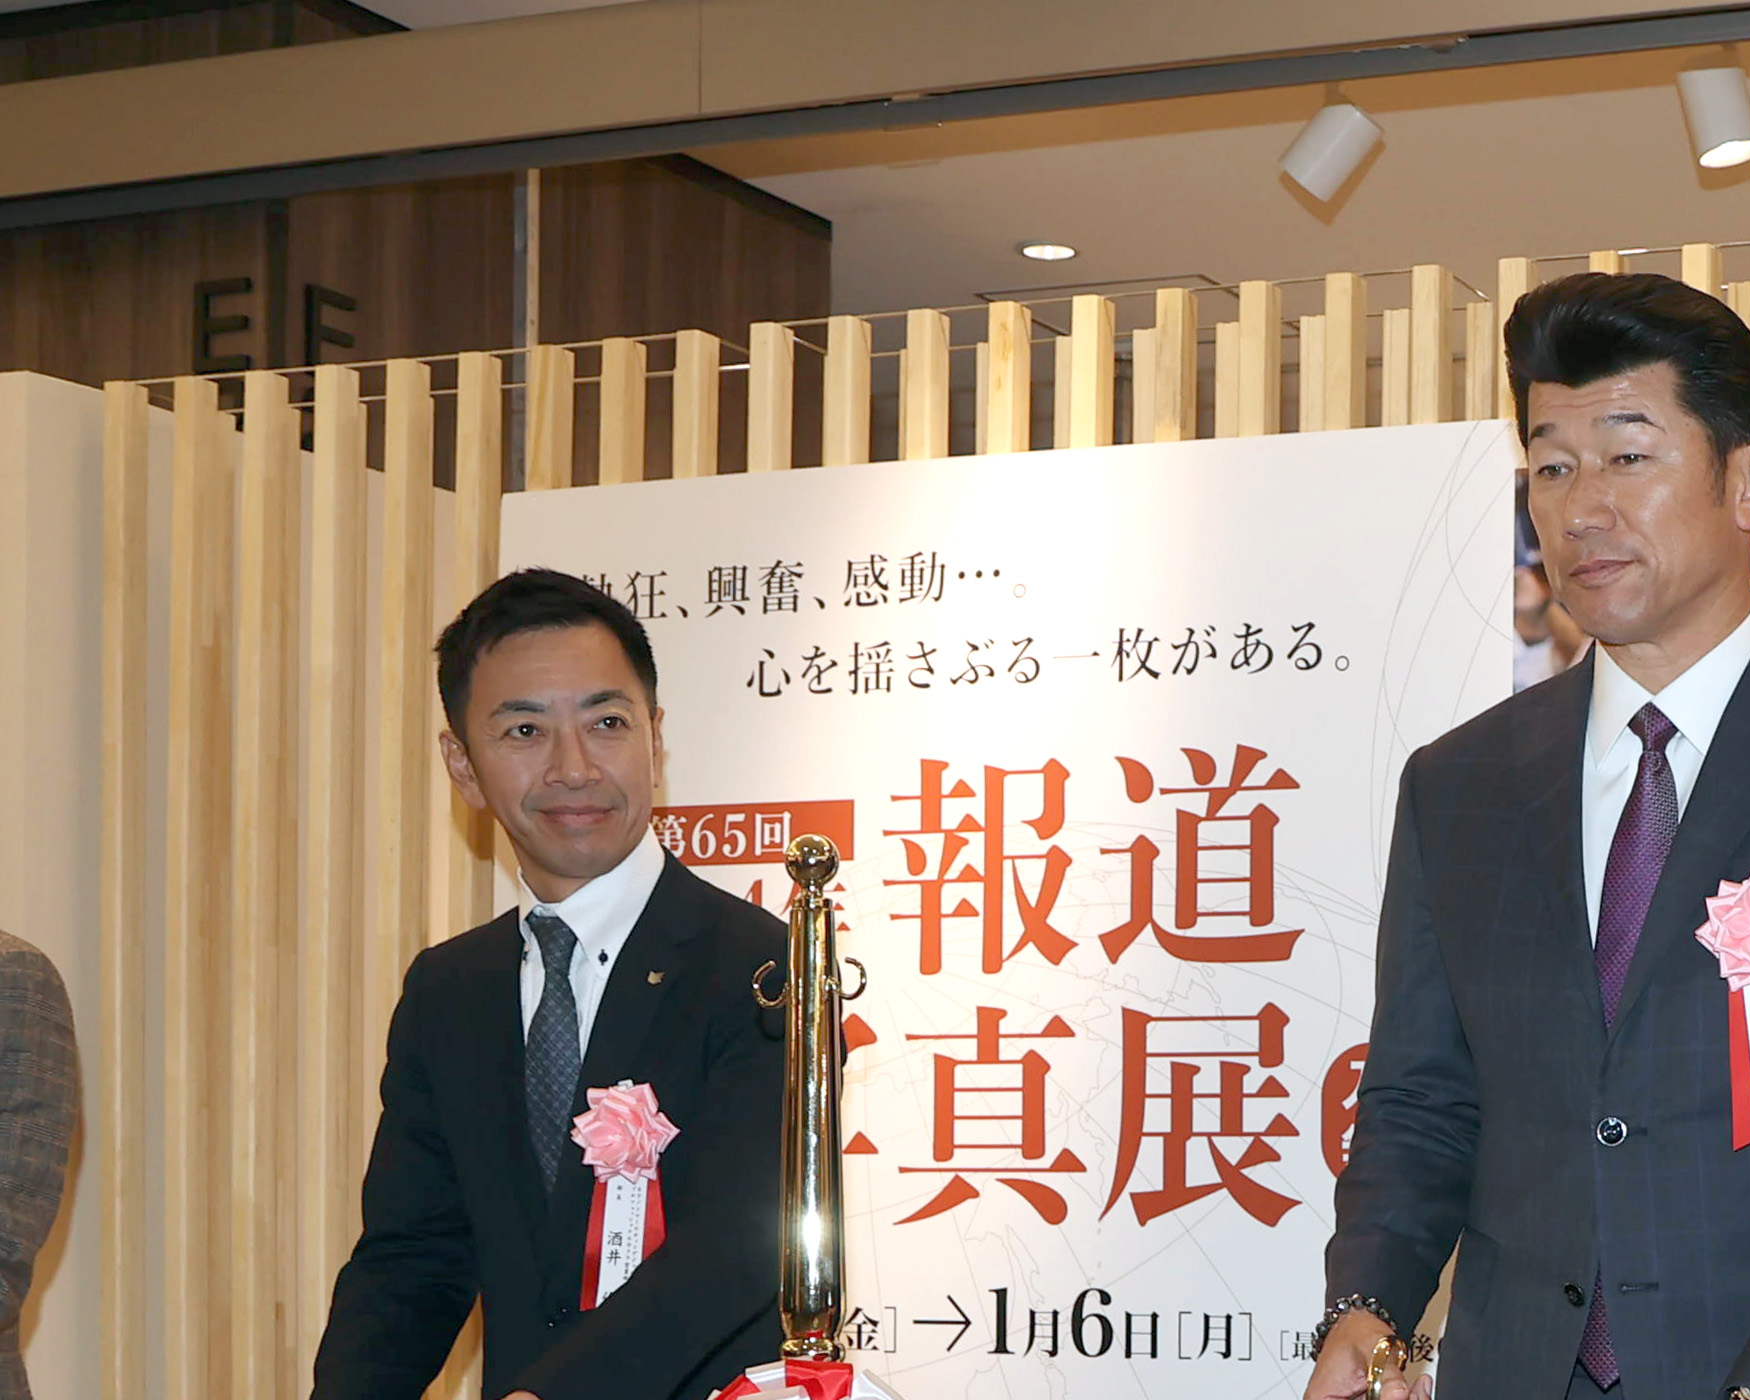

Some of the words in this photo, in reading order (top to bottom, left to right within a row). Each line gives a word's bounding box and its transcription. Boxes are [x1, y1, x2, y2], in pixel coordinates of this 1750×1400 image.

[746, 622, 1350, 698] 心を揺さぶる一枚がある。
[651, 811, 791, 859] 第65回
[882, 743, 1304, 975] 報道
[607, 1231, 622, 1266] 酒井
